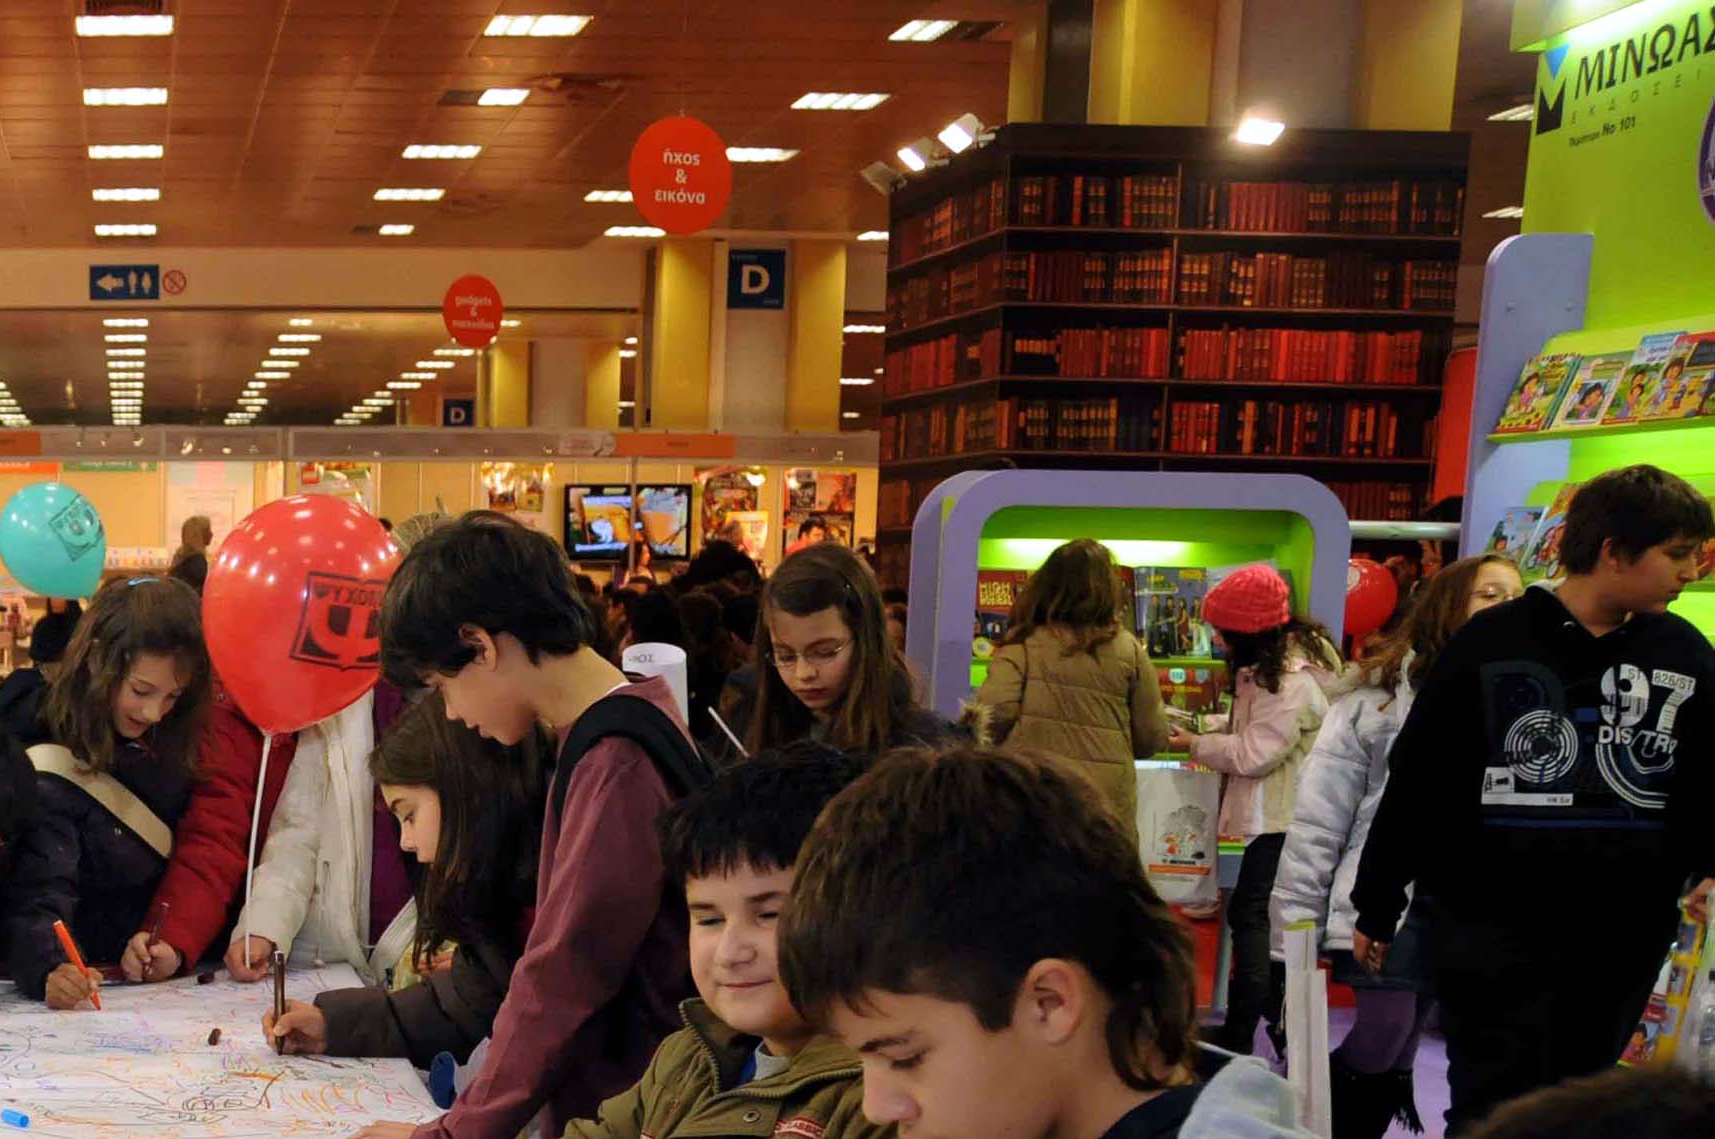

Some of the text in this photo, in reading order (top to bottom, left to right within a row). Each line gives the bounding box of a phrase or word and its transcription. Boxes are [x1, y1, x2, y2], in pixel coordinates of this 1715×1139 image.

[1619, 116, 1636, 132] 101
[663, 148, 701, 167] ήχος
[675, 168, 687, 184] &
[654, 186, 706, 206] εικόνα
[741, 264, 770, 295] D
[450, 407, 465, 424] D
